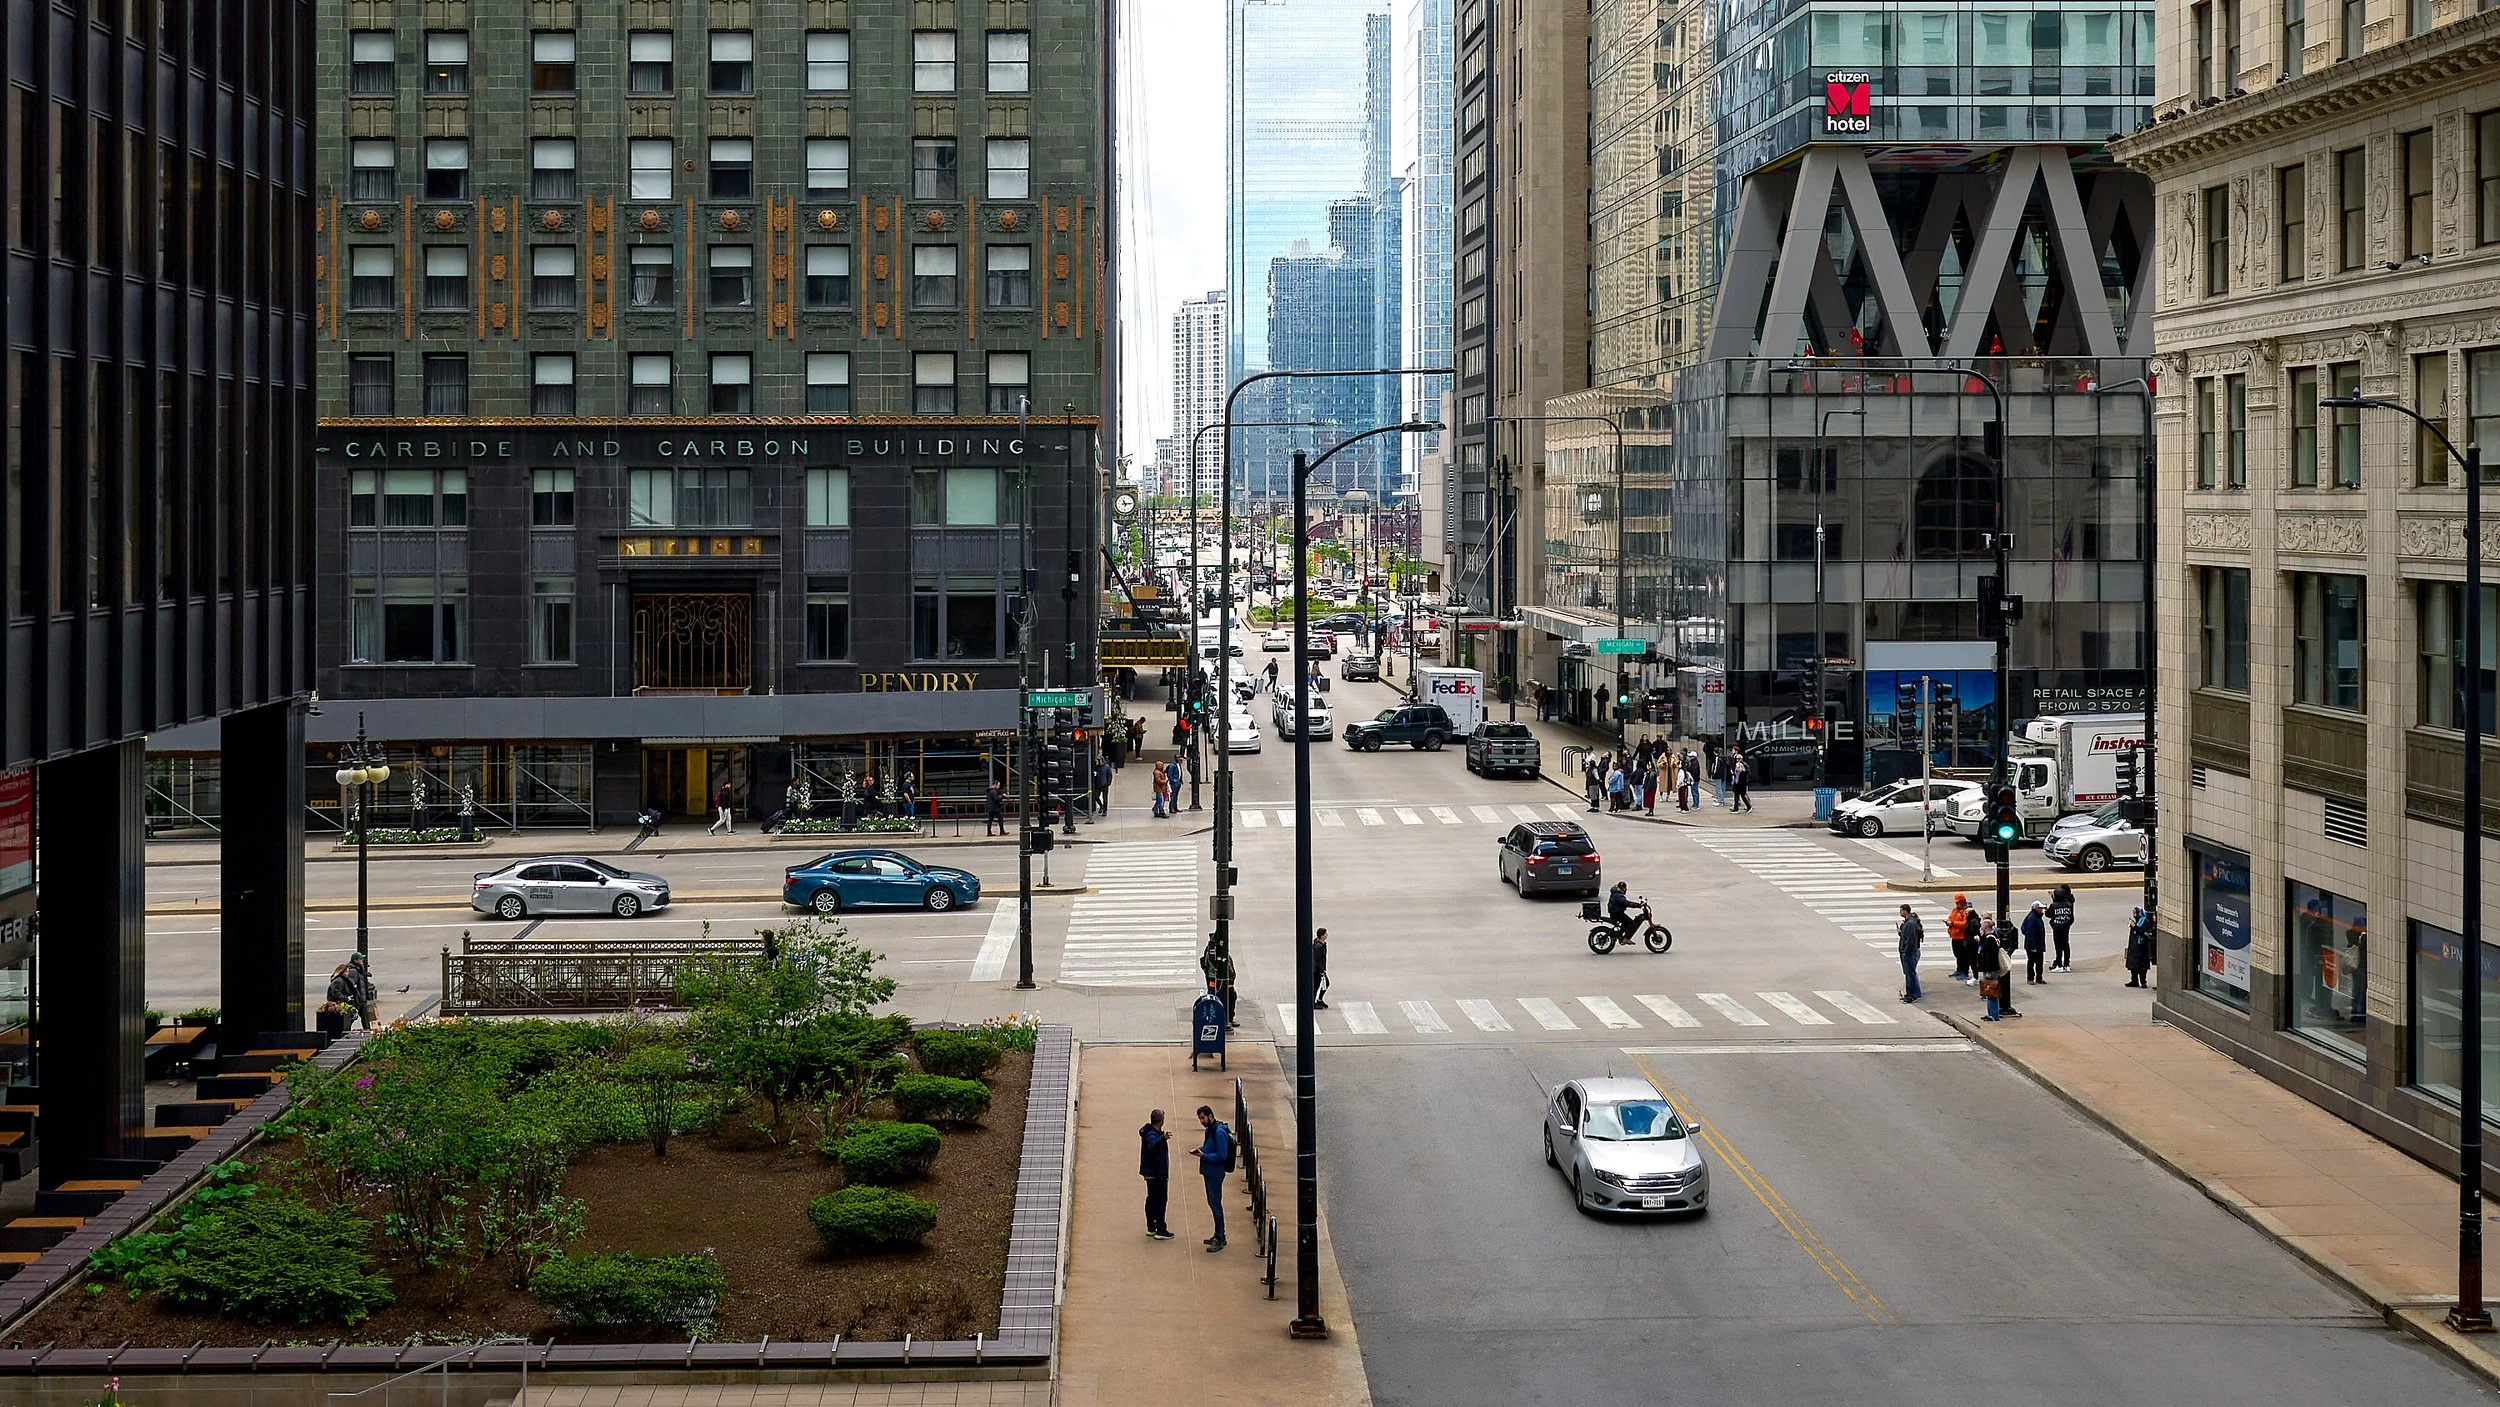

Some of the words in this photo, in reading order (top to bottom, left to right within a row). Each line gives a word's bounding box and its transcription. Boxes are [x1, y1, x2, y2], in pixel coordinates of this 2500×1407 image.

[1827, 70, 1870, 83] citizen
[1827, 115, 1870, 131] hotel
[345, 440, 512, 457] CARBIDE
[552, 440, 621, 457] AND
[657, 439, 809, 457] CARBON
[847, 438, 1025, 457] BUILDING
[1446, 465, 1455, 481] Inn
[1446, 482, 1455, 513] Garden
[1446, 514, 1454, 542] Hilton
[859, 671, 980, 693] PENDRY
[1431, 680, 1477, 695] FedEx
[1035, 695, 1067, 706] Michigan
[2033, 688, 2082, 698] RETAIL
[2087, 688, 2134, 698] SPACE
[2039, 701, 2080, 711] FROM
[1736, 720, 1854, 741] MILLIE
[1780, 744, 1819, 752] MICHIGA
